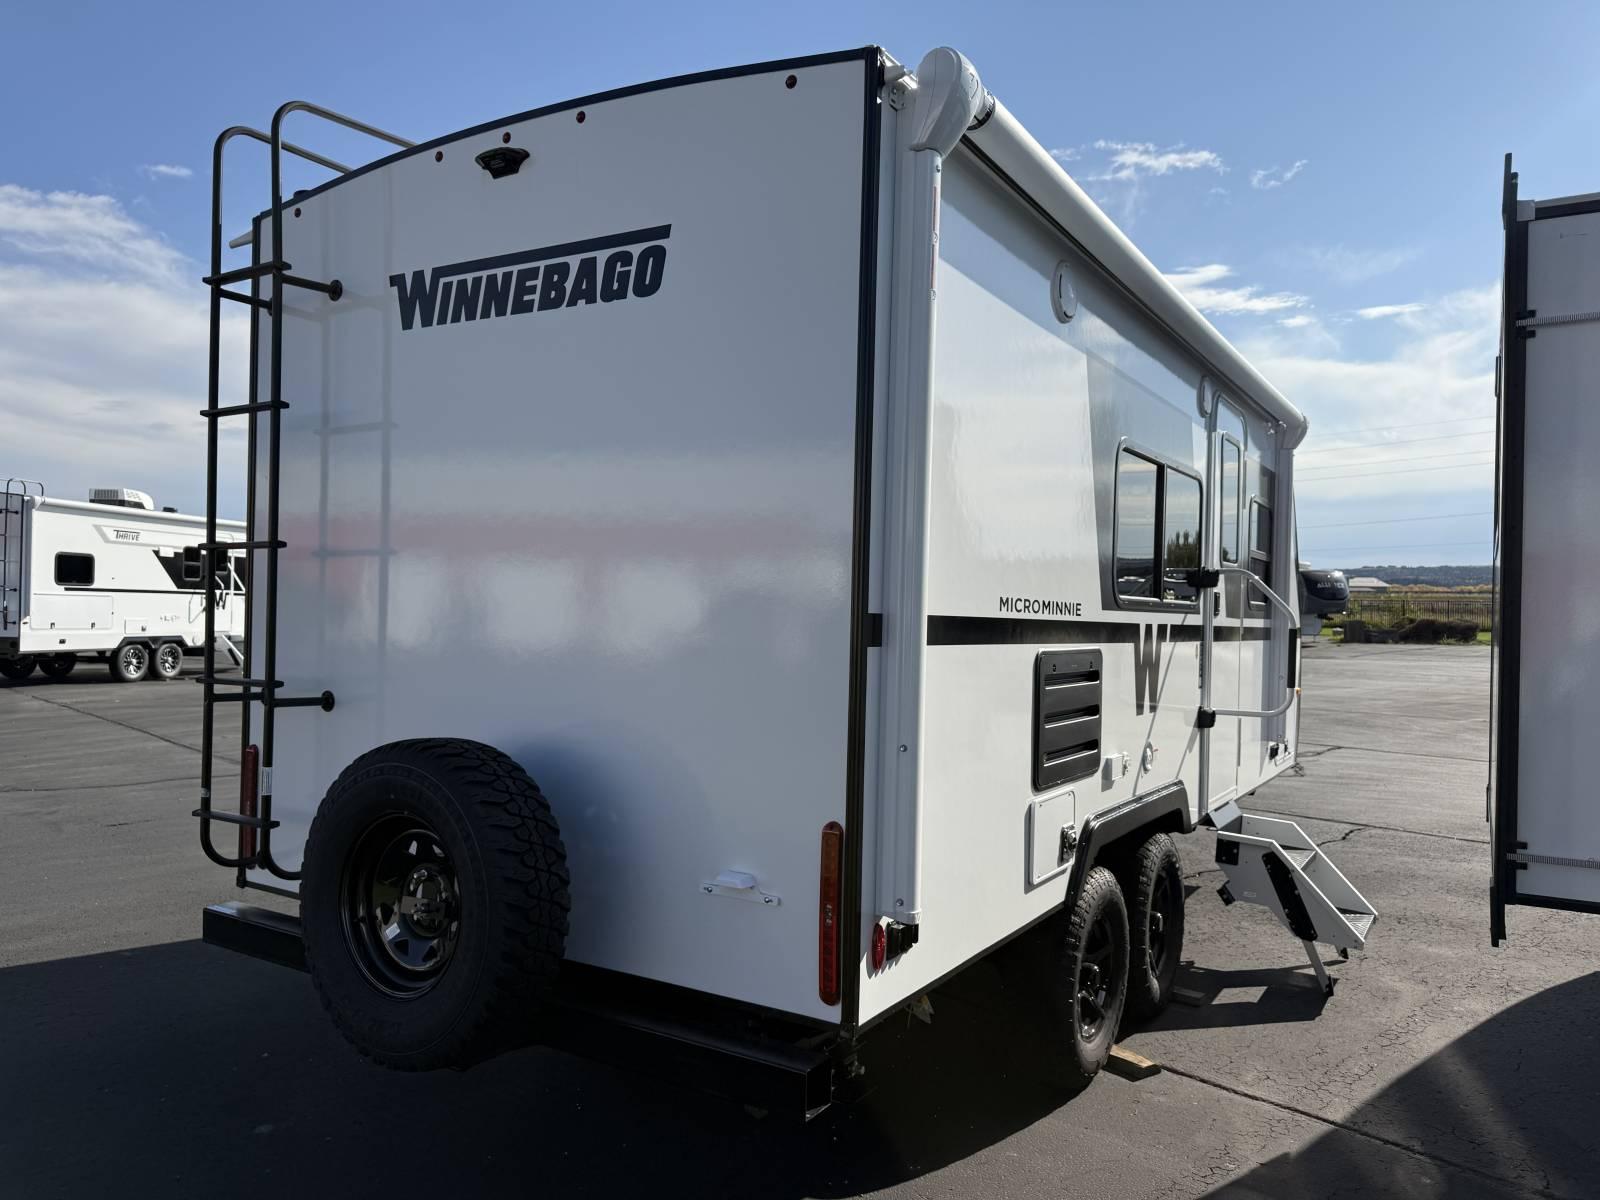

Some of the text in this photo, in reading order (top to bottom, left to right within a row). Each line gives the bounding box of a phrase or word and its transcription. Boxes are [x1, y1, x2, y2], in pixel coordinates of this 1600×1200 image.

[389, 223, 672, 331] WINNEBAGO
[113, 529, 141, 541] THRIVE
[999, 596, 1082, 617] MICROMINNIE
